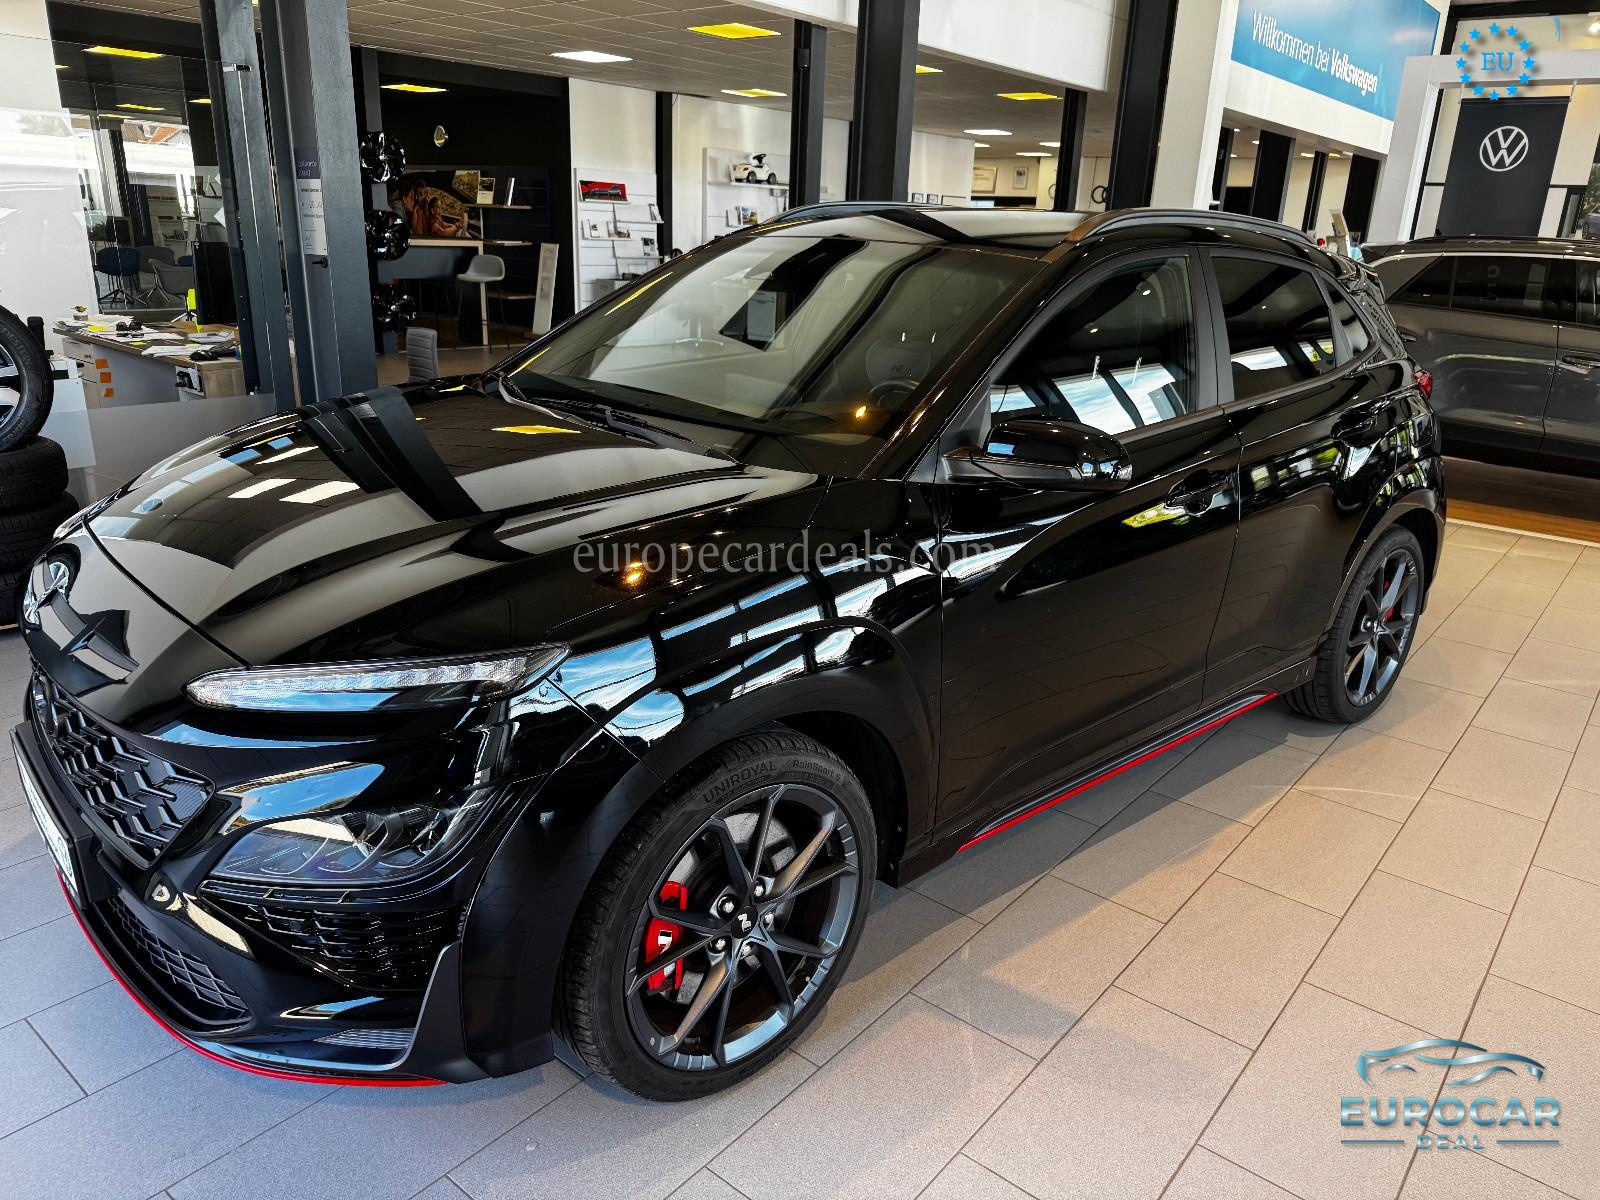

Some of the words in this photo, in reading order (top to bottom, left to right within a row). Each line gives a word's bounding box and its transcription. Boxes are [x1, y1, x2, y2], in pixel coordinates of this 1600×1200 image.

[1252, 9, 1315, 67] Willkommen
[1314, 41, 1332, 73] bei
[1330, 47, 1378, 97] Volkswagen
[702, 760, 778, 804] UNIROYAL
[792, 758, 835, 779] RainSport
